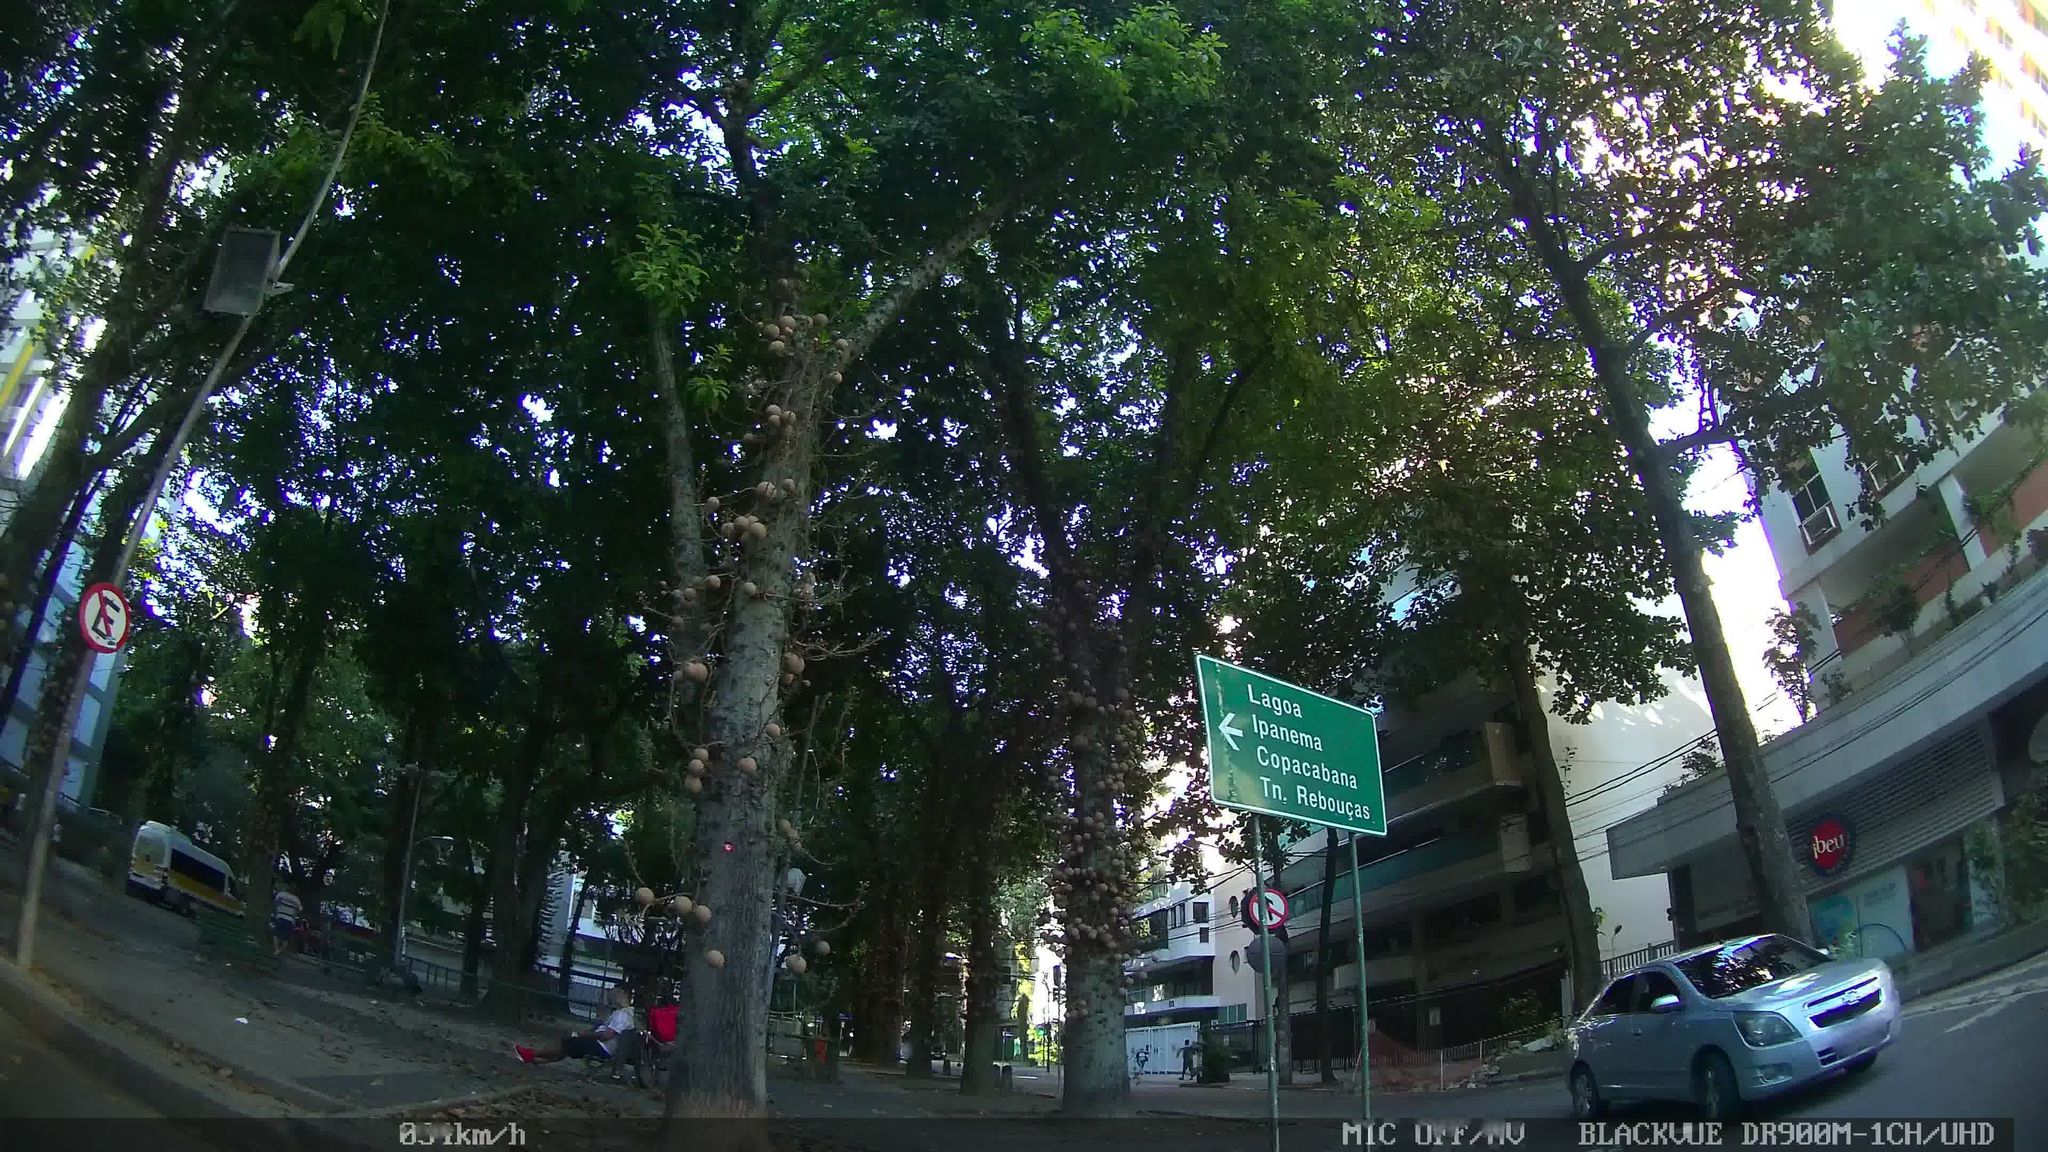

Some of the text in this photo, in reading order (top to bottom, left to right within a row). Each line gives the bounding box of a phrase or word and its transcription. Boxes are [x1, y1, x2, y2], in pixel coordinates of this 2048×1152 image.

[1247, 684, 1303, 718] Lagoa
[1252, 714, 1323, 751] Ipanema
[1256, 745, 1358, 789] Copacabana
[1260, 776, 1371, 821] Tn. Rebouças
